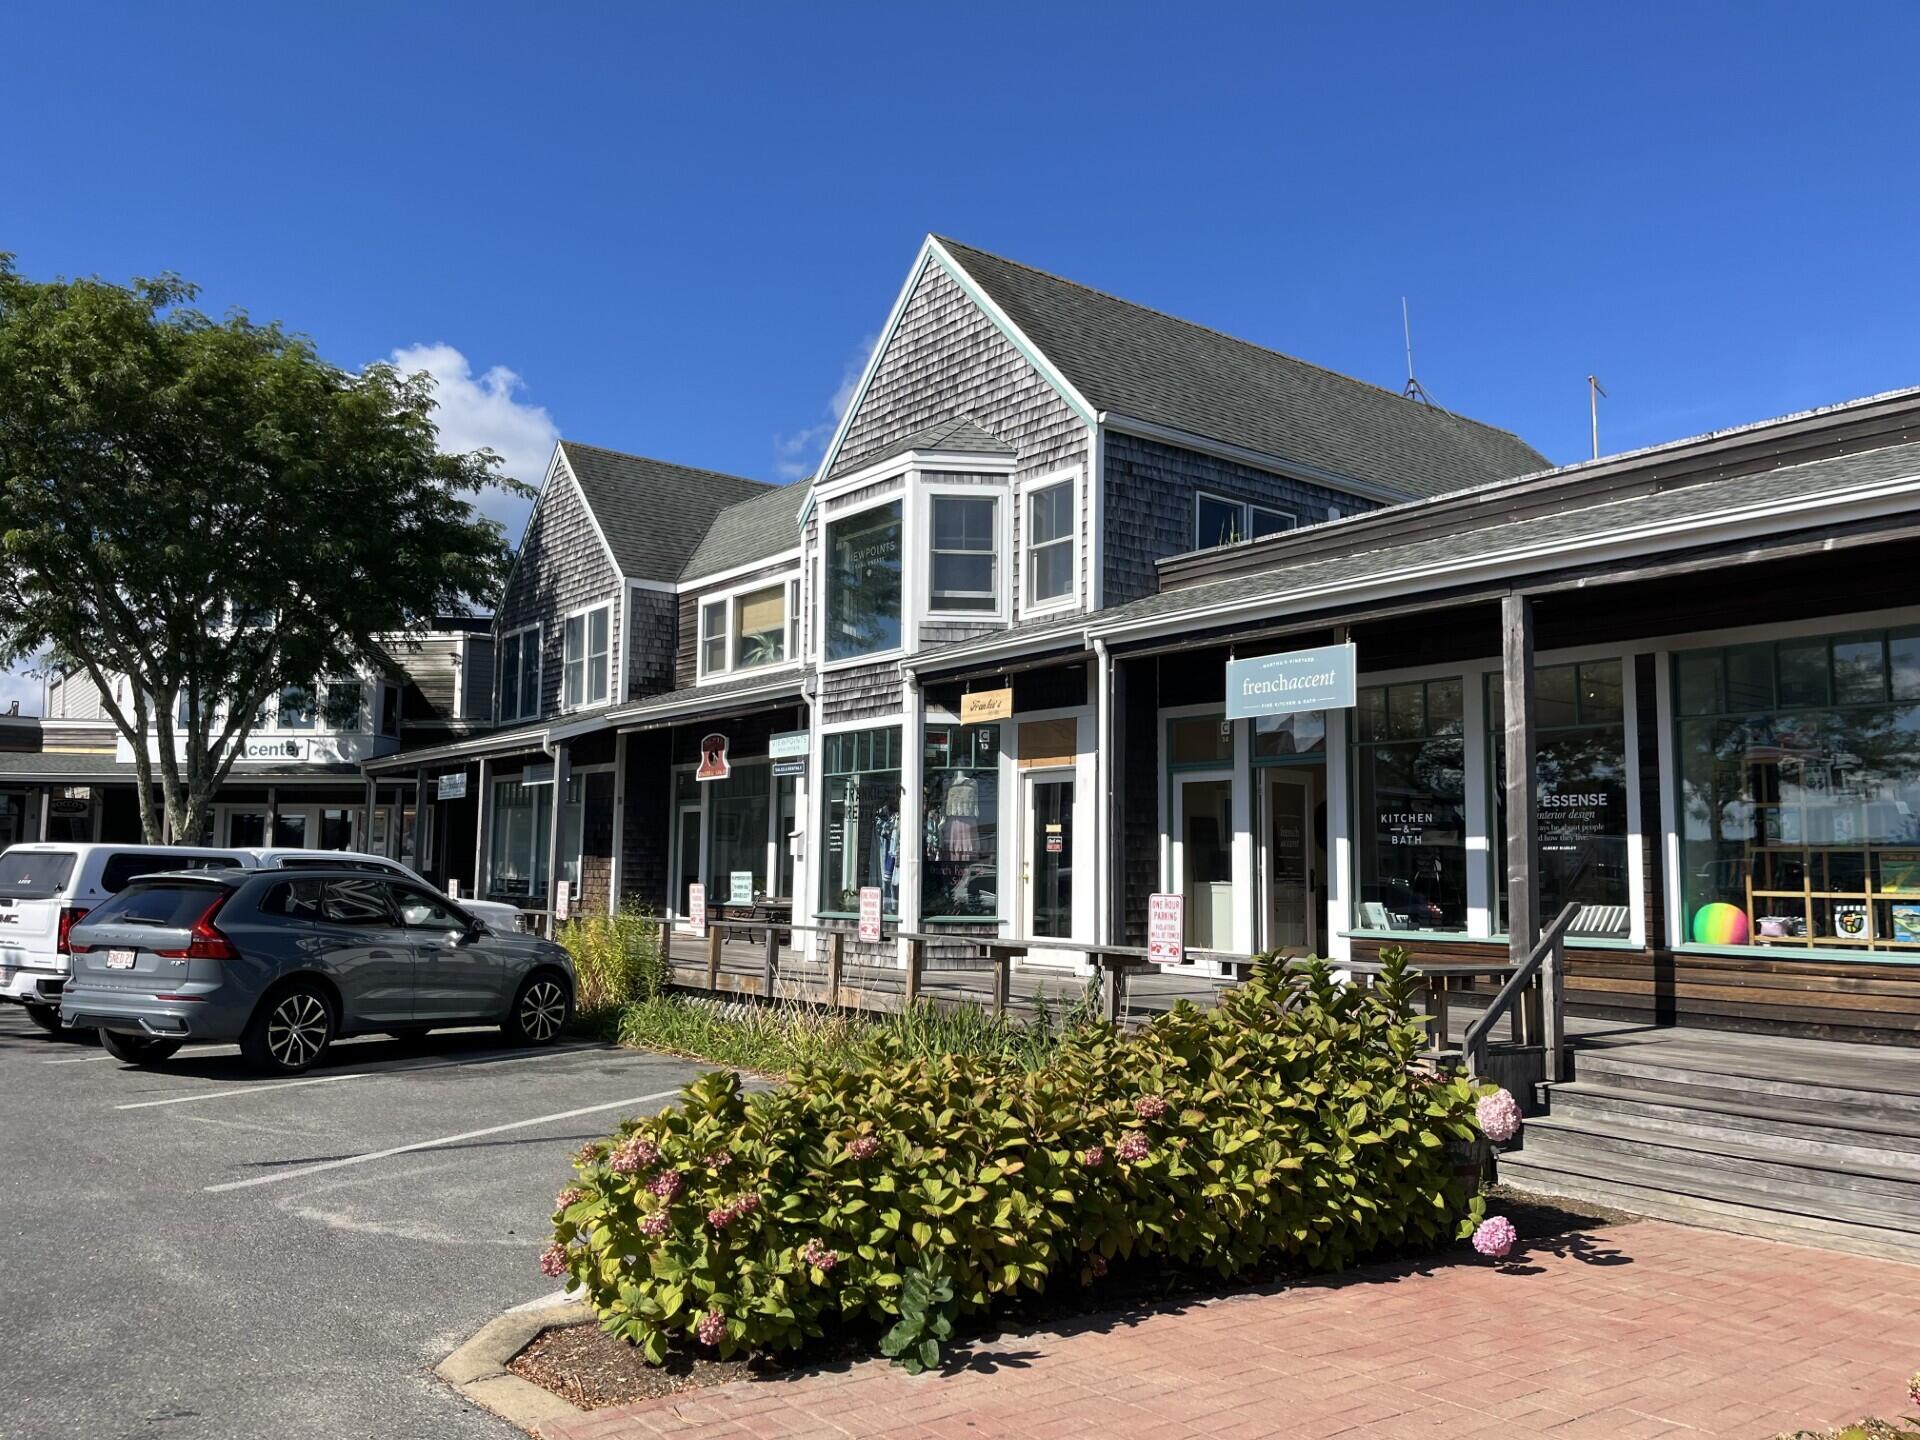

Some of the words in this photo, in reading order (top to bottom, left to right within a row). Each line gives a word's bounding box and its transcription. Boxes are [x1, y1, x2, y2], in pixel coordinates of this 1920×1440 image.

[1242, 669, 1336, 696] frenchaccent
[970, 698, 1002, 711] Frankie's
[772, 736, 807, 747] VIEWPOINTS
[248, 742, 304, 756] center
[1543, 793, 1608, 807] ESSENSE
[1380, 813, 1433, 823] KITCHEN
[1537, 808, 1567, 819] interior
[1568, 808, 1596, 821] design
[1403, 825, 1409, 833] &
[1582, 823, 1604, 832] people
[1391, 835, 1422, 845] BATH
[1152, 901, 1163, 909] ONE
[1164, 900, 1180, 909] HOUR
[1153, 911, 1177, 921] PARKING
